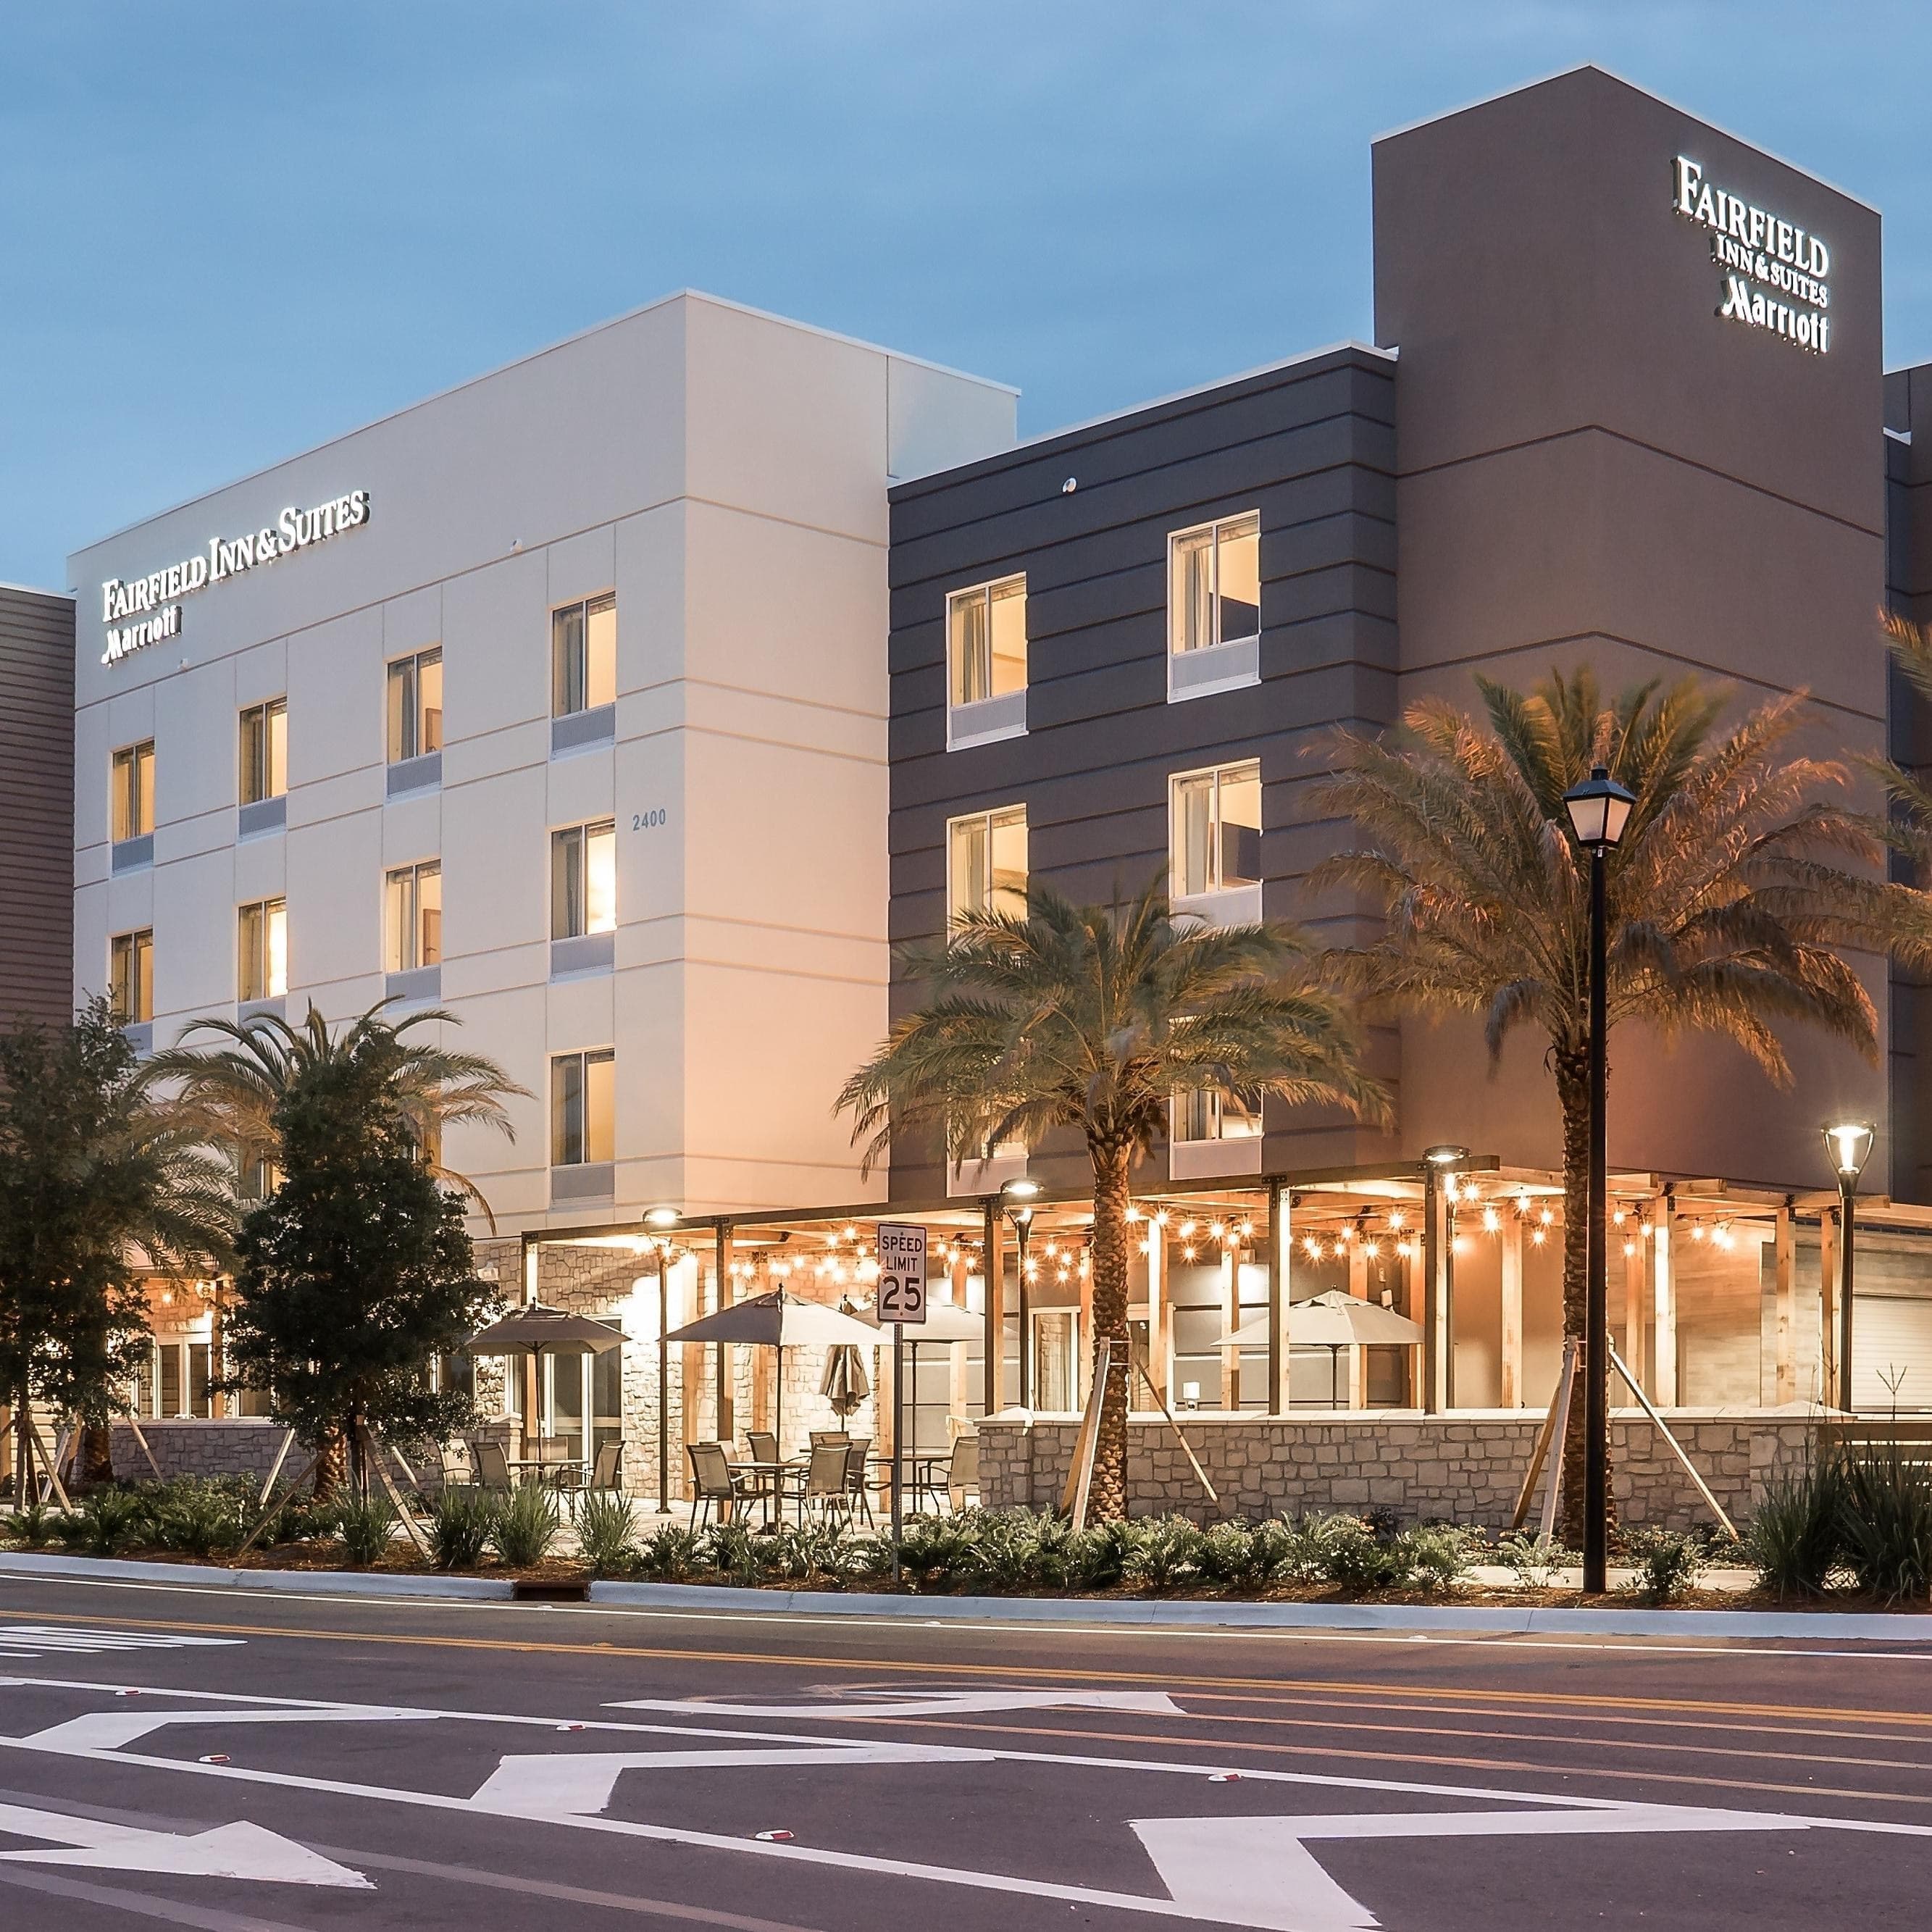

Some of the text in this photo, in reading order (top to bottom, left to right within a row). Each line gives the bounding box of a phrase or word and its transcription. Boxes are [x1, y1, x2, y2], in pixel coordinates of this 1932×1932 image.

[1676, 155, 1830, 278] FAIRFIELD
[1716, 233, 1754, 275] INN
[1770, 261, 1828, 309] SUITES
[1721, 275, 1828, 354] Marriott
[102, 556, 208, 623] FAIRFIELD
[101, 604, 179, 665] Marriott
[633, 808, 666, 832] 2400
[882, 1235, 923, 1253] SPEED
[886, 1256, 918, 1272] LIMIT
[882, 1276, 921, 1312] 25
